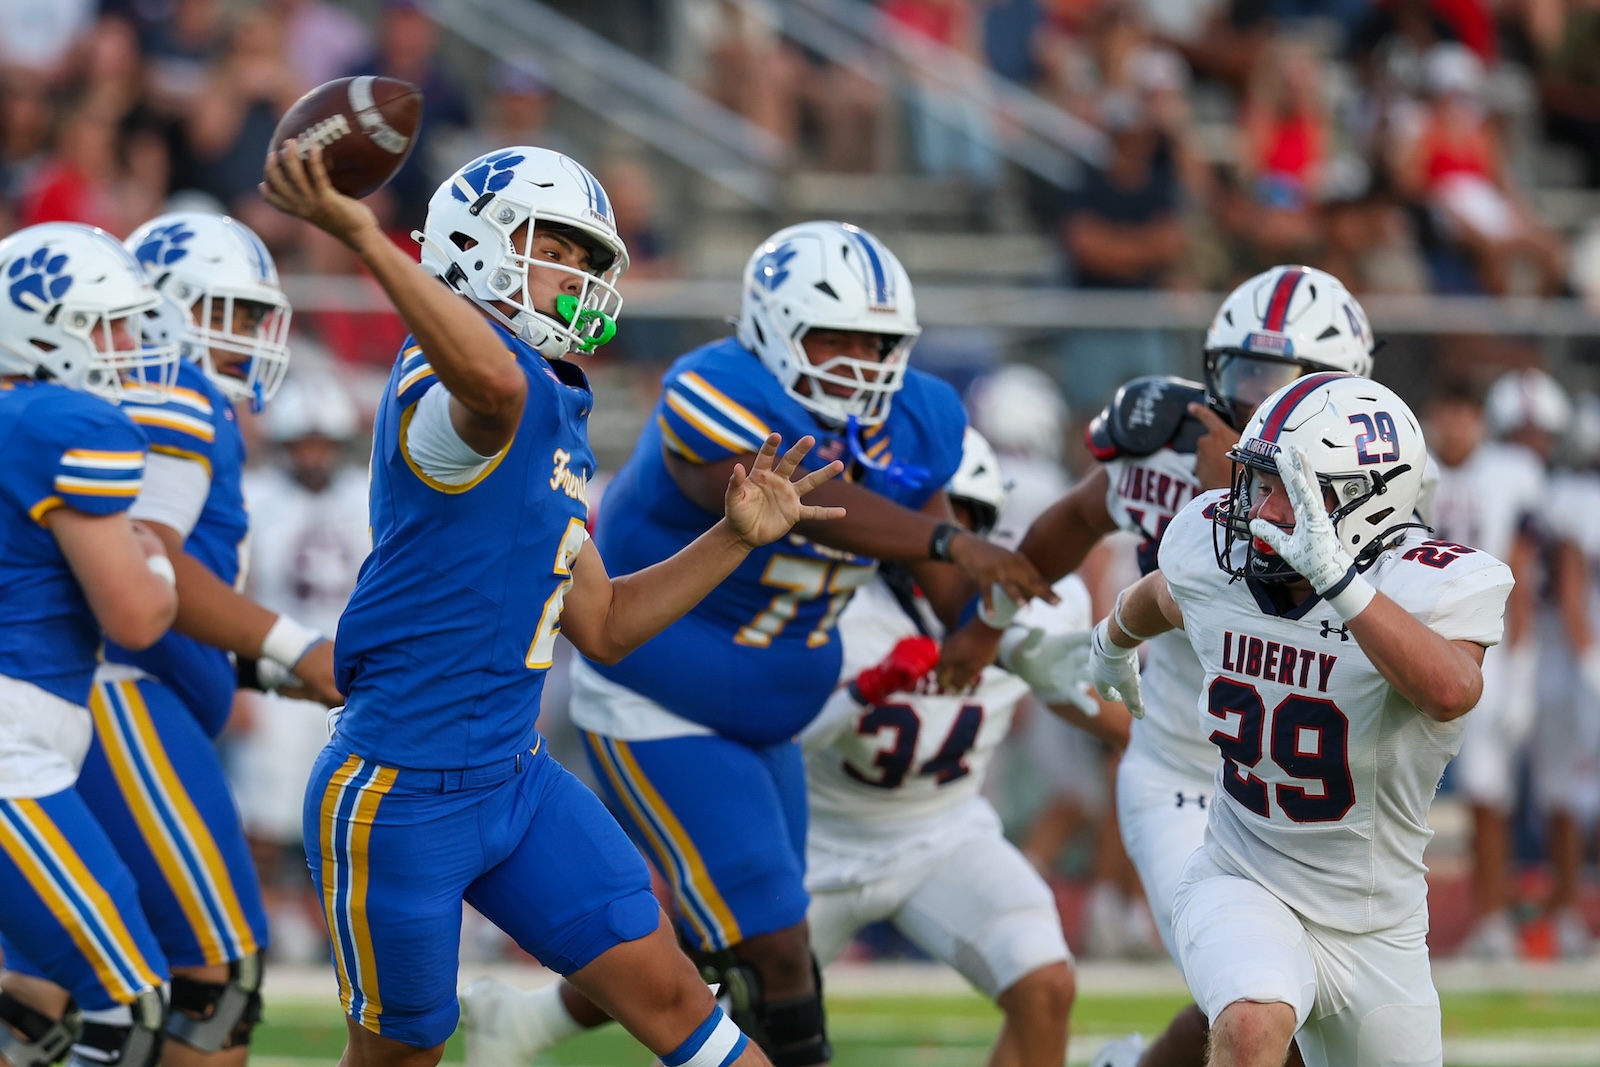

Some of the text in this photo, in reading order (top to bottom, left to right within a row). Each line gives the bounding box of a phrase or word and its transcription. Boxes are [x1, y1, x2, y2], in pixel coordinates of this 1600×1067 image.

[1247, 438, 1278, 458] LIBERTY
[1348, 411, 1400, 466] 29
[733, 554, 878, 648] 77
[1222, 631, 1338, 692] LIBERTY
[843, 702, 984, 790] 34
[1208, 675, 1356, 823] 29
